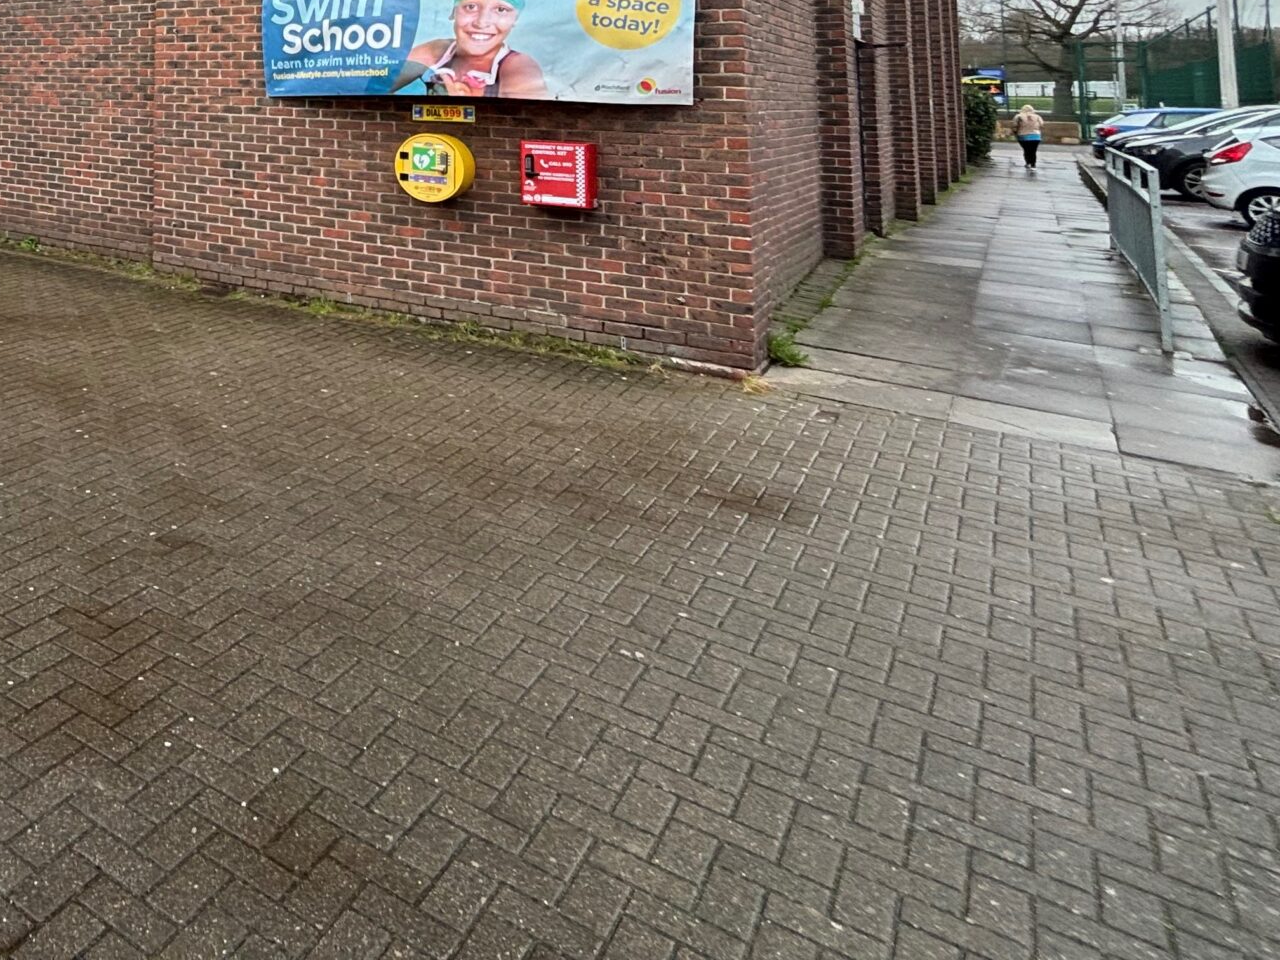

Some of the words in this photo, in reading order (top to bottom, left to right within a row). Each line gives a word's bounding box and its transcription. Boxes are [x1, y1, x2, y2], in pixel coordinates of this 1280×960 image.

[592, 12, 660, 35] today!
[282, 14, 403, 54] School
[271, 59, 302, 70] Learn
[304, 58, 315, 68] to
[316, 55, 343, 67] swim
[345, 53, 371, 67] with
[374, 55, 399, 66] us...
[655, 87, 682, 95] fusion
[426, 108, 441, 117] DIAL
[443, 109, 461, 118] 999
